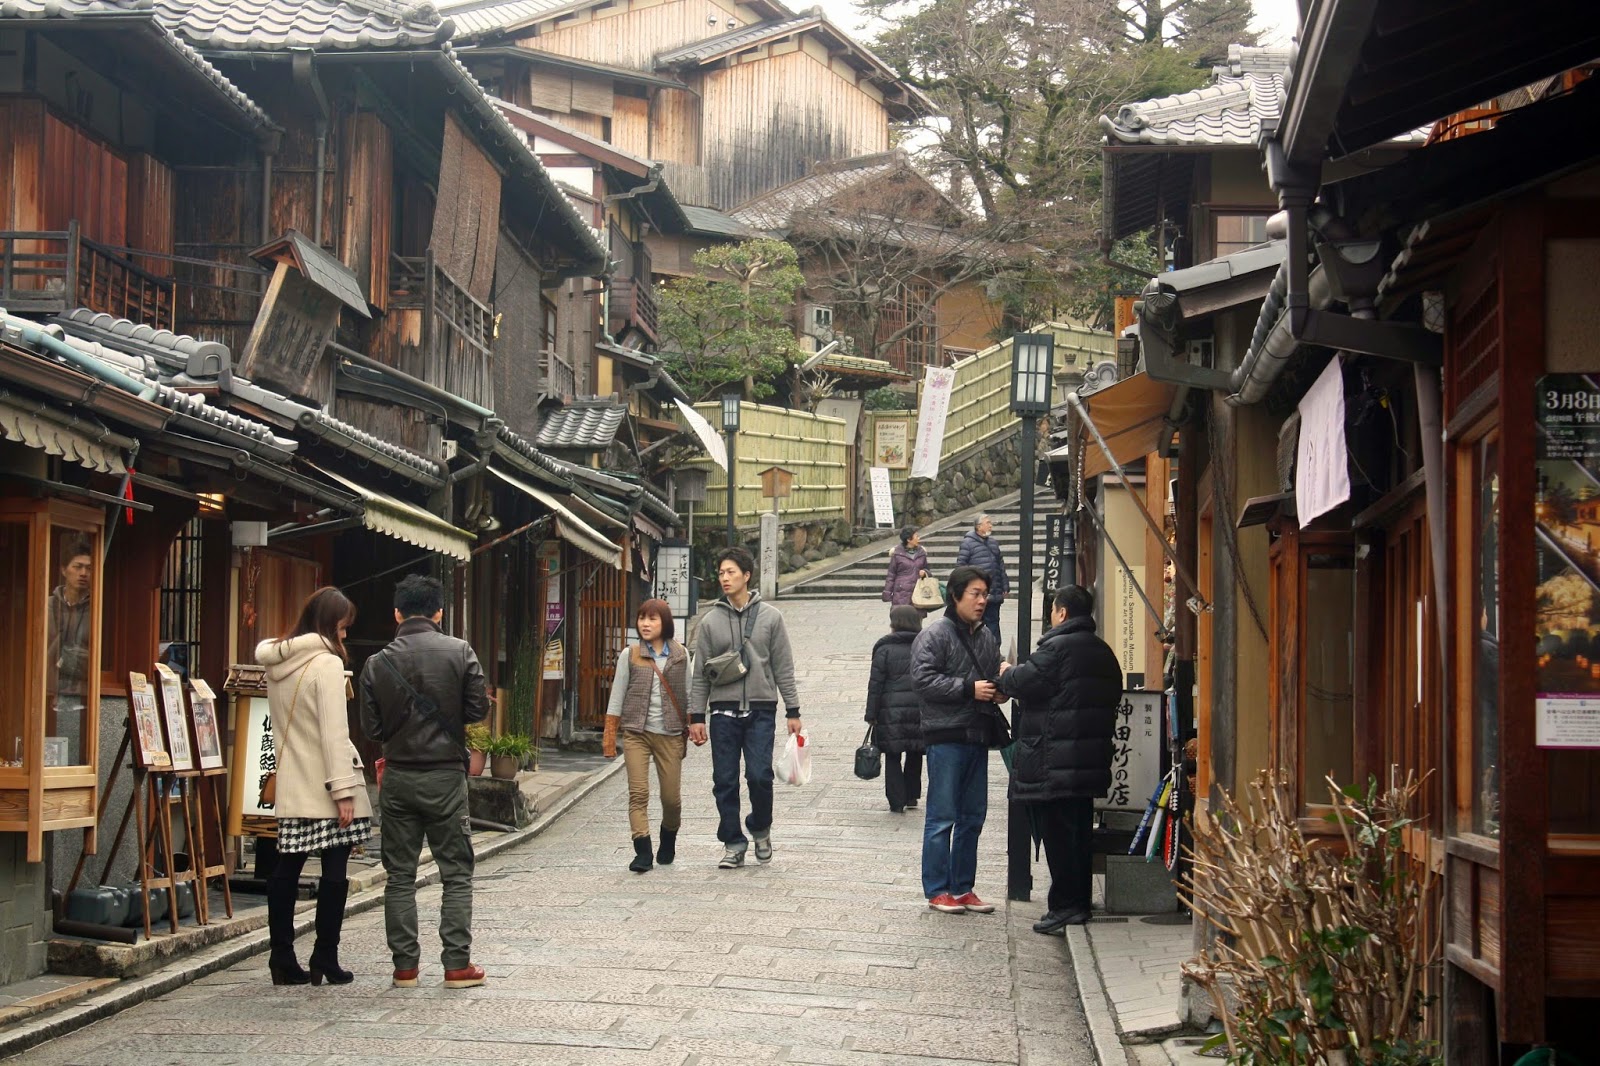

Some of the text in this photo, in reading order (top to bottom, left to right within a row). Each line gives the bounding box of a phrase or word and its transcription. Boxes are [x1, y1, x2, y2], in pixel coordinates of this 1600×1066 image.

[1546, 390, 1600, 410] 3月8日
[680, 553, 688, 580] そば処
[1046, 545, 1060, 590] きんつば
[1144, 704, 1152, 737] 製造元
